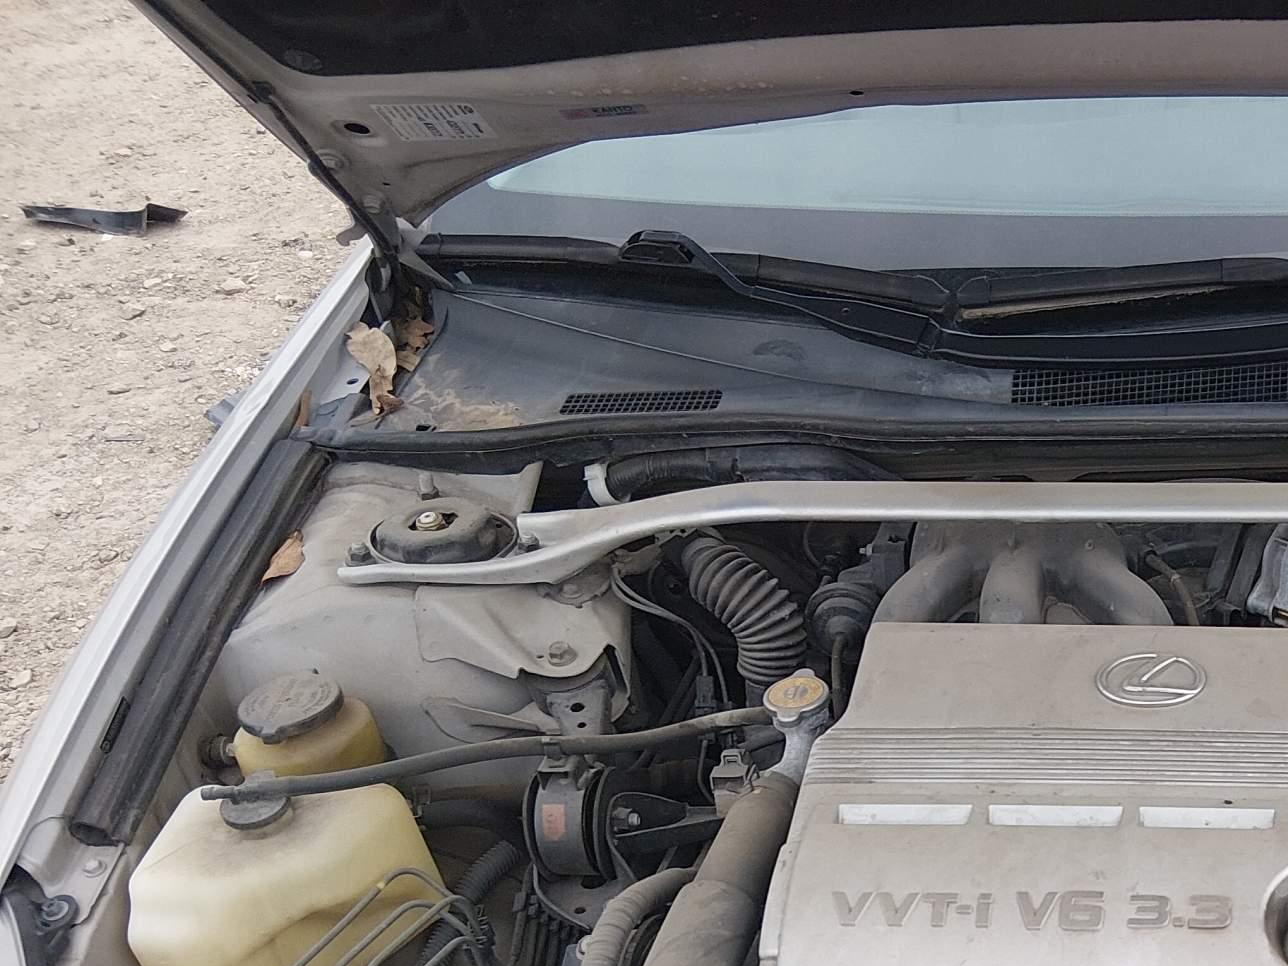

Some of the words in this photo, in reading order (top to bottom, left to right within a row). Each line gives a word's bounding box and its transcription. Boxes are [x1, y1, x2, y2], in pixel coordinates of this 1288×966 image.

[831, 889, 993, 929] VVT-i
[1015, 888, 1105, 932] V6
[1126, 893, 1234, 930] 3.3
